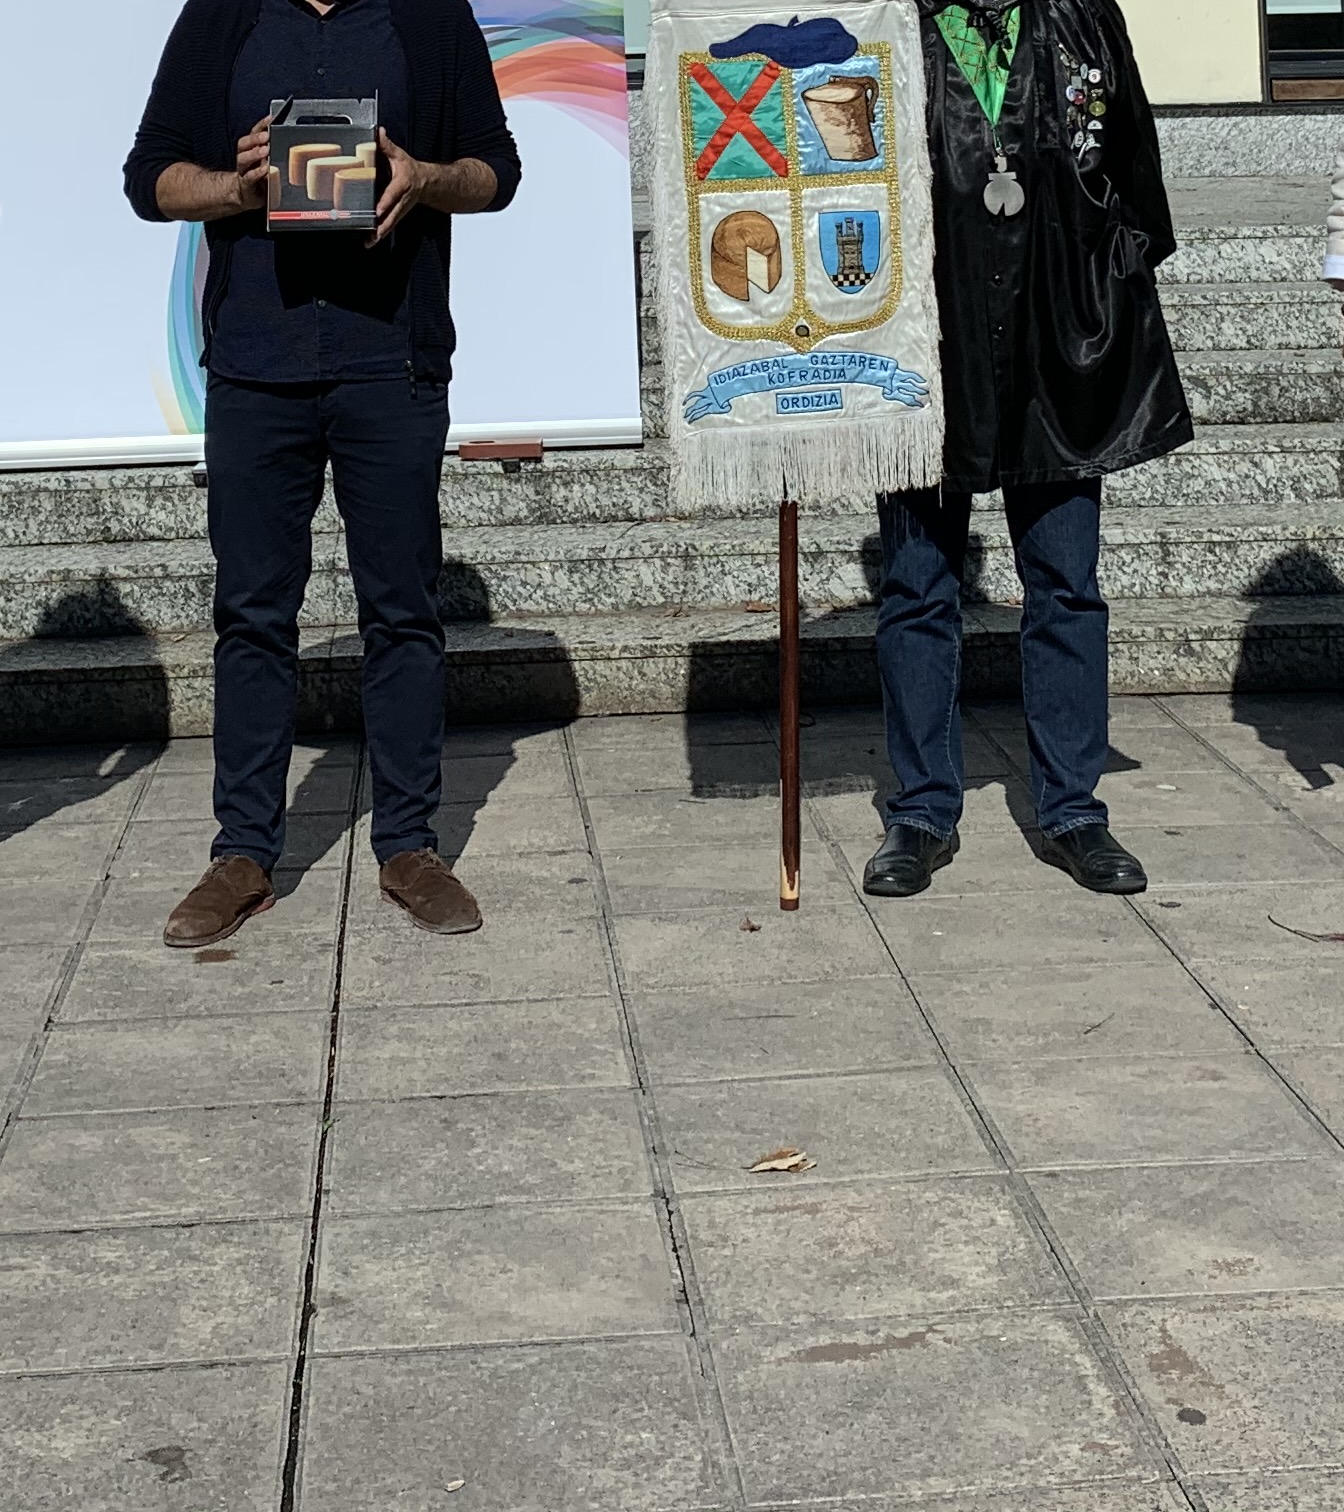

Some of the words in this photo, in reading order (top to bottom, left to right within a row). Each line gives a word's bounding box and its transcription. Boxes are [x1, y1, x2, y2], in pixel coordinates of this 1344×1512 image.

[714, 358, 789, 386] IDIAZABAL
[810, 354, 891, 373] GAZTAREN
[768, 368, 847, 386] KOFRADIA
[780, 393, 839, 411] ORDIZIA
